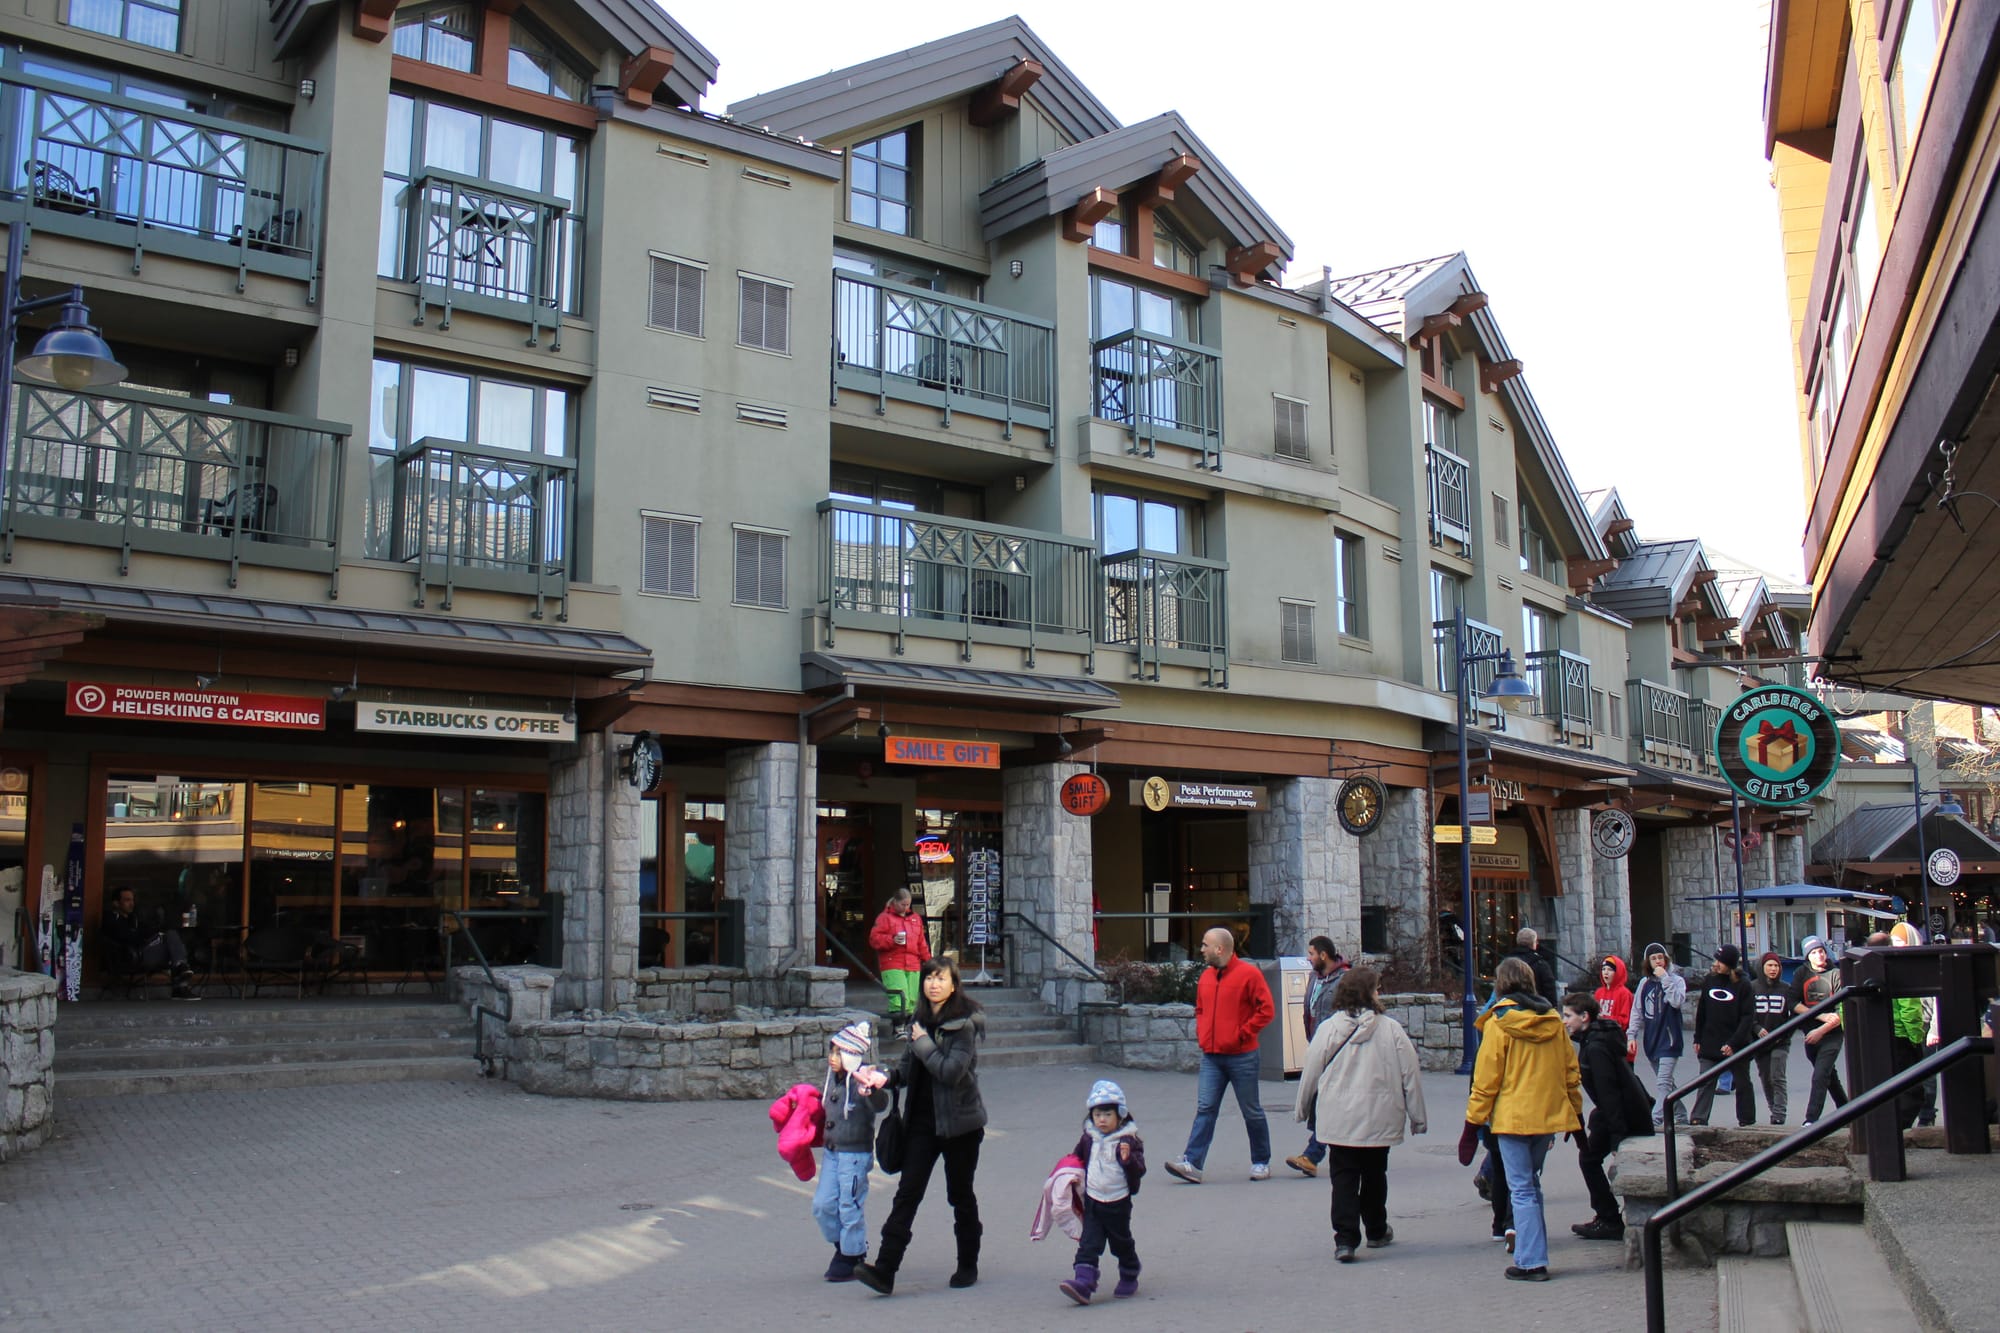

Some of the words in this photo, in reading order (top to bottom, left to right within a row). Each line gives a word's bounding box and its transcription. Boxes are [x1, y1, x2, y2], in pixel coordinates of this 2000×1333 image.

[116, 688, 171, 701] POWDER
[173, 692, 239, 705] MOUNTAIN
[112, 701, 214, 719] HELISKIING
[217, 708, 229, 719] &
[232, 708, 320, 724] CATSKIING
[1733, 693, 1820, 721] CARLBERGS
[375, 708, 488, 730] STARBUCKS
[494, 716, 560, 734] COFFEE
[895, 740, 945, 761] SMILE
[953, 744, 991, 763] GIFT
[1069, 781, 1097, 795] SMILE
[1181, 785, 1201, 796] Peak
[1203, 786, 1253, 798] Performance
[1746, 778, 1810, 800] GIFTS
[1071, 795, 1095, 809] GIFT
[1174, 796, 1209, 806] Physiotherapy
[1215, 798, 1237, 807] Massage
[1237, 799, 1257, 808] Therapy
[1594, 812, 1610, 830] ROCKS
[1616, 813, 1631, 830] GEMS
[914, 842, 951, 855] OPEN
[1600, 846, 1626, 857] CANADA
[1478, 855, 1494, 865] ROCKS
[1932, 851, 1955, 862] BEACON
